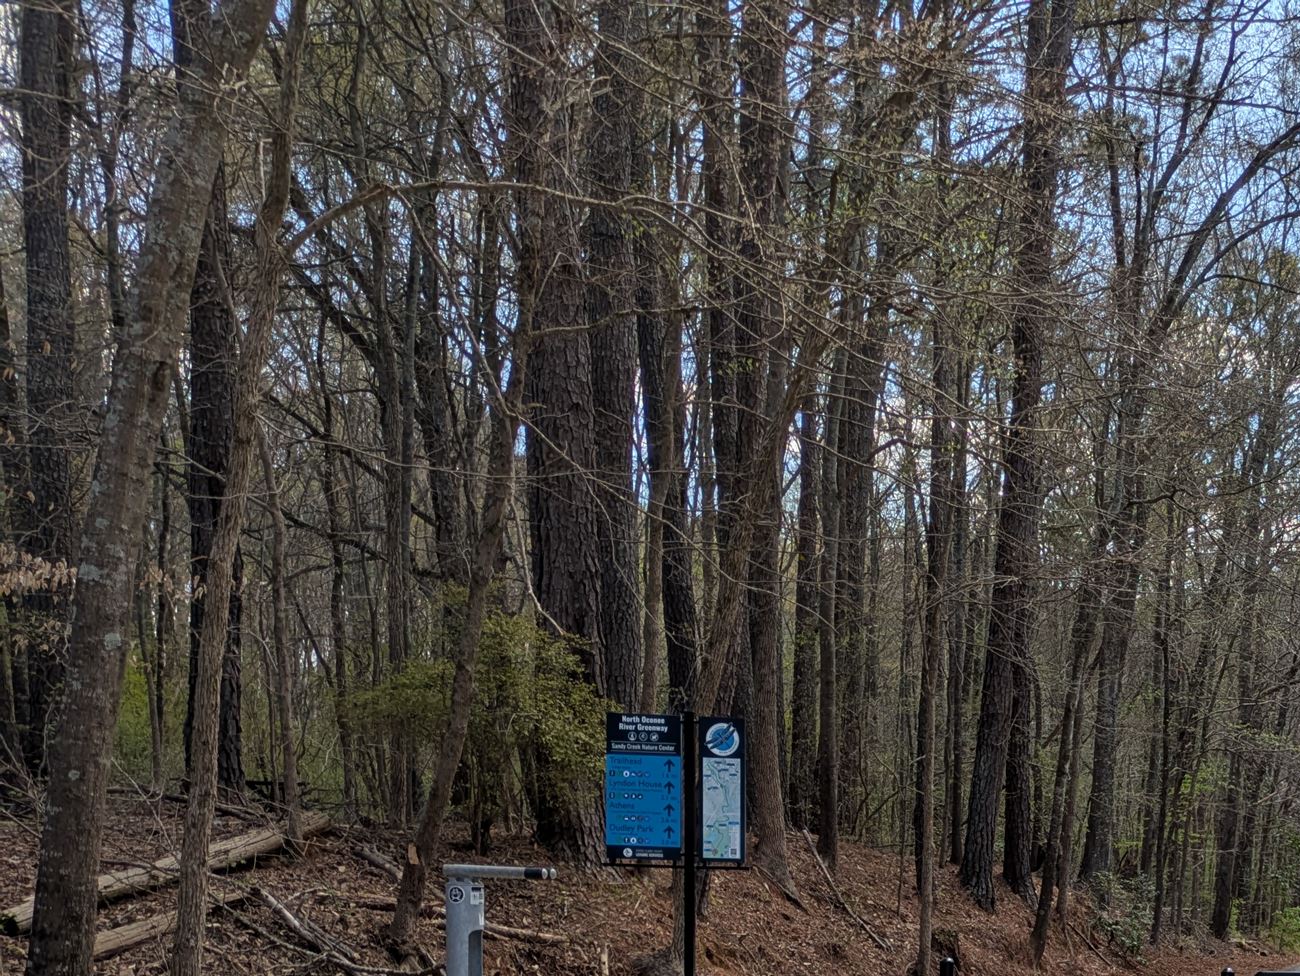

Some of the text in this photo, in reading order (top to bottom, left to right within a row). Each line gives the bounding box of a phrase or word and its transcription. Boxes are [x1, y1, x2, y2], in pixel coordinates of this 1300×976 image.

[622, 715, 665, 724] North Oconee
[618, 722, 668, 733] River Greenway
[611, 742, 626, 750] Sandy
[609, 756, 642, 765] Trailhead
[638, 779, 662, 788] House
